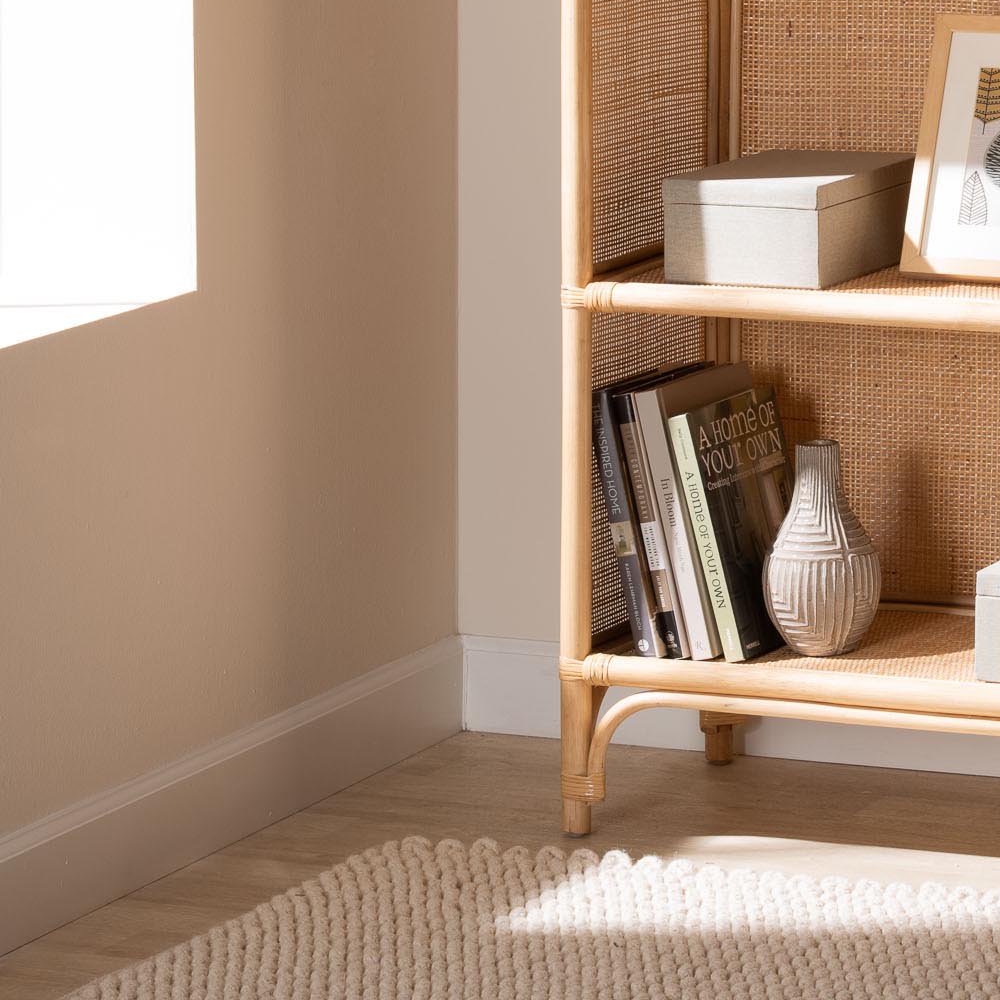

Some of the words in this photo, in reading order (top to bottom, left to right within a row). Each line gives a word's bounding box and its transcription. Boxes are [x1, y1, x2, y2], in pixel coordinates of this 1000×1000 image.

[592, 402, 604, 425] THE
[699, 425, 712, 450] A
[758, 401, 775, 427] OF
[597, 427, 614, 478] INSPIRED
[746, 427, 782, 460] OWN
[606, 480, 621, 515] HOME
[660, 478, 670, 490] In
[664, 491, 677, 527] Bloom
[685, 471, 694, 481] A
[698, 524, 709, 539] OF
[712, 578, 726, 608] OWN
